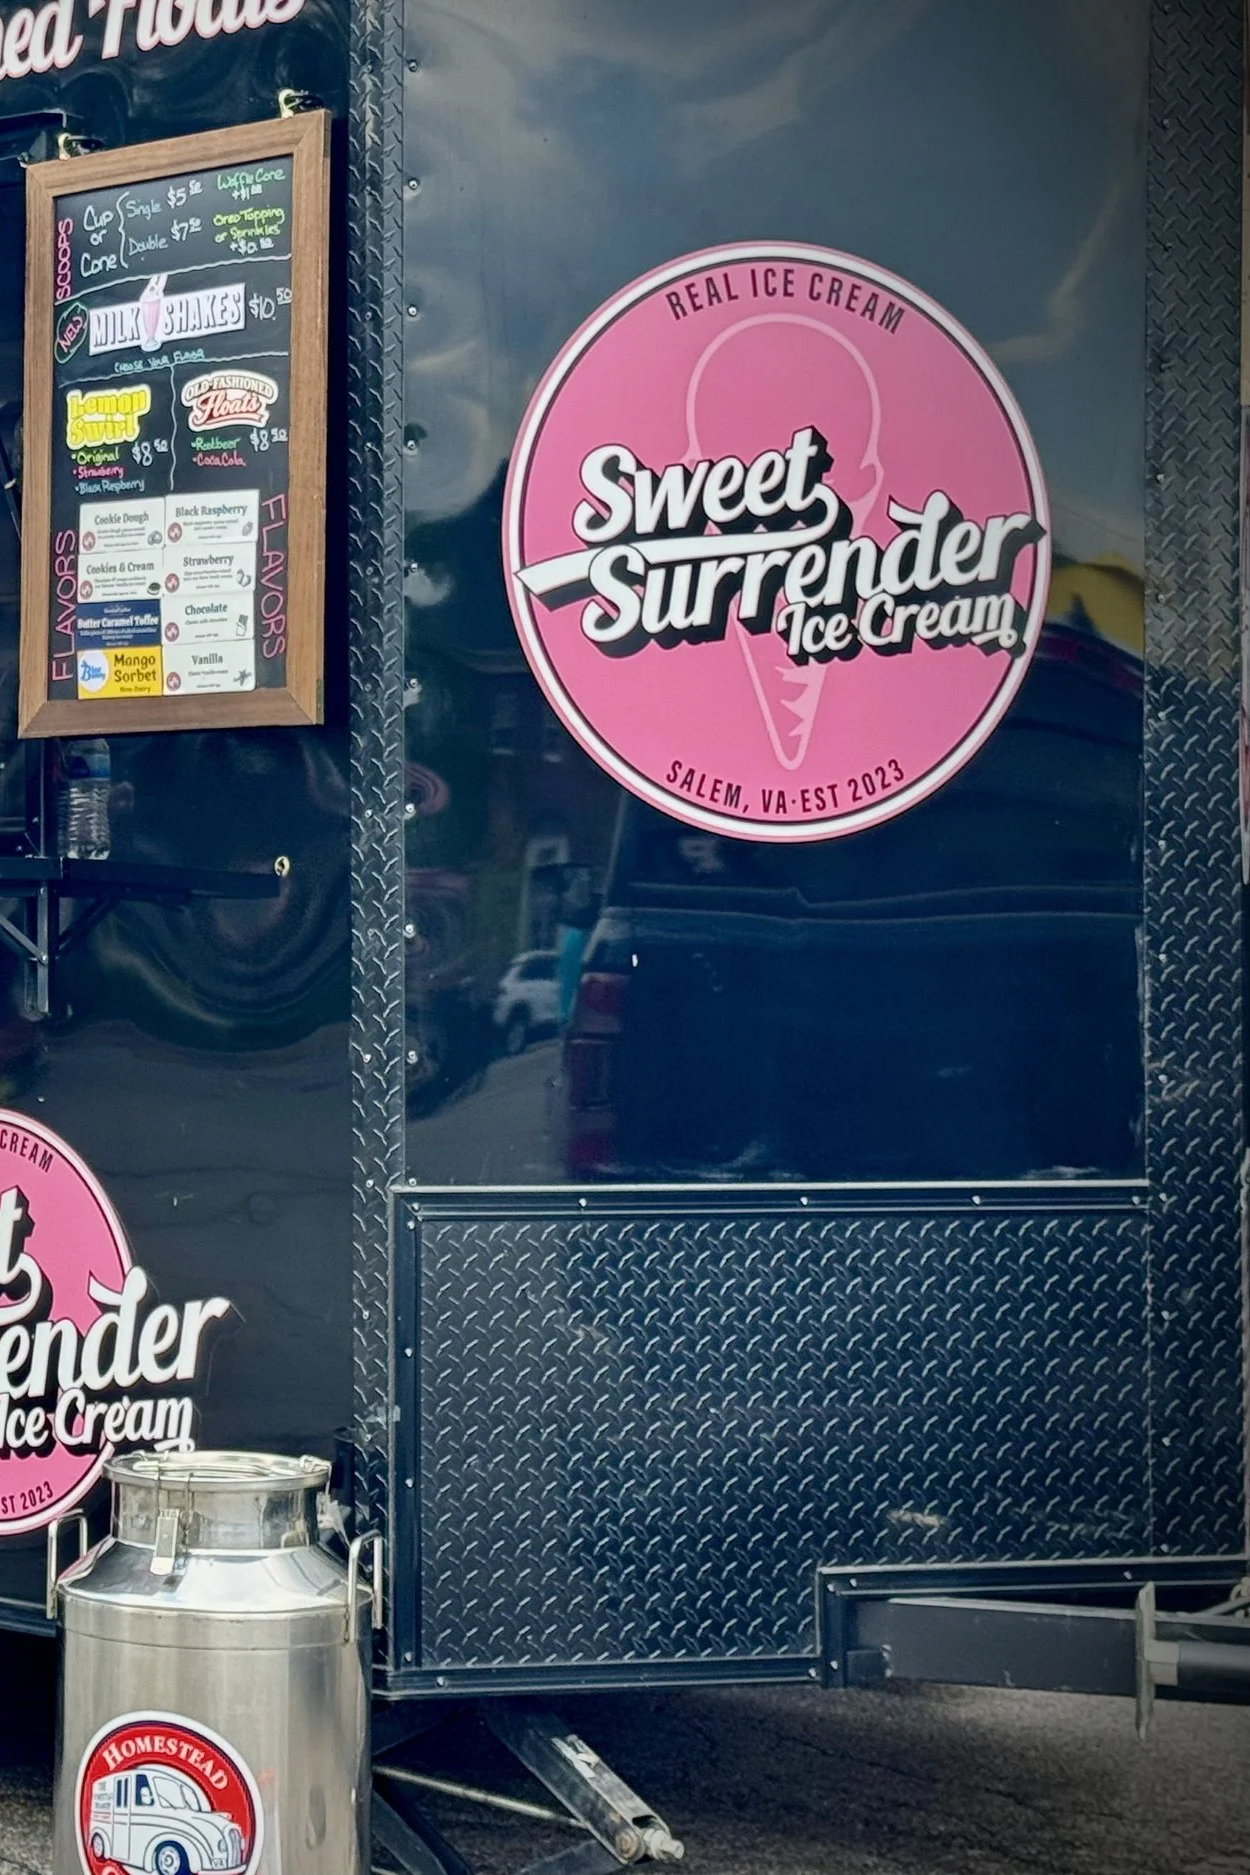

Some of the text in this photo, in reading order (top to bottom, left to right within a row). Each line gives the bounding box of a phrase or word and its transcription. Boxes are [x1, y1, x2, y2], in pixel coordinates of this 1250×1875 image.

[255, 168, 286, 183] Cone
[83, 205, 113, 231] Cup
[125, 198, 162, 220] Single
[213, 207, 285, 228] Oreo Topping
[90, 229, 108, 245] or
[128, 233, 168, 256] Double
[215, 224, 281, 243] or Sprinkles
[56, 217, 73, 300] SCOOPS
[80, 252, 118, 278] Cone
[666, 268, 907, 336] REAL ICE CREAM
[92, 291, 242, 348] MILK SHAKES
[59, 316, 82, 352] NEW
[185, 375, 274, 402] OLD-FASHIONED
[69, 388, 147, 418] Lemon
[192, 389, 261, 426] Floats
[70, 414, 136, 445] Swirl
[77, 446, 119, 466] Original
[572, 425, 840, 543] Sweet
[94, 511, 149, 525] Cookie Dough
[175, 504, 248, 517] Black Raspberry
[86, 562, 154, 574] Cookies & Cream
[183, 554, 234, 567] Strawberry
[580, 490, 1037, 645] Surrender
[260, 493, 287, 659] FLAVORS
[51, 528, 75, 682] FLAVORS
[185, 603, 228, 616] Chocolate
[101, 615, 133, 628] Caramel
[134, 613, 159, 626] Toffee
[776, 591, 1017, 656] Ice Cream
[114, 654, 156, 670] Mango
[191, 653, 224, 665] Vanilla
[113, 668, 157, 683] Sorbet
[666, 760, 749, 814] SALEM,
[846, 759, 907, 803] 2023
[0, 1129, 54, 1173] CREAM
[54, 1387, 195, 1452] Cream
[20, 1481, 54, 1509] 2023
